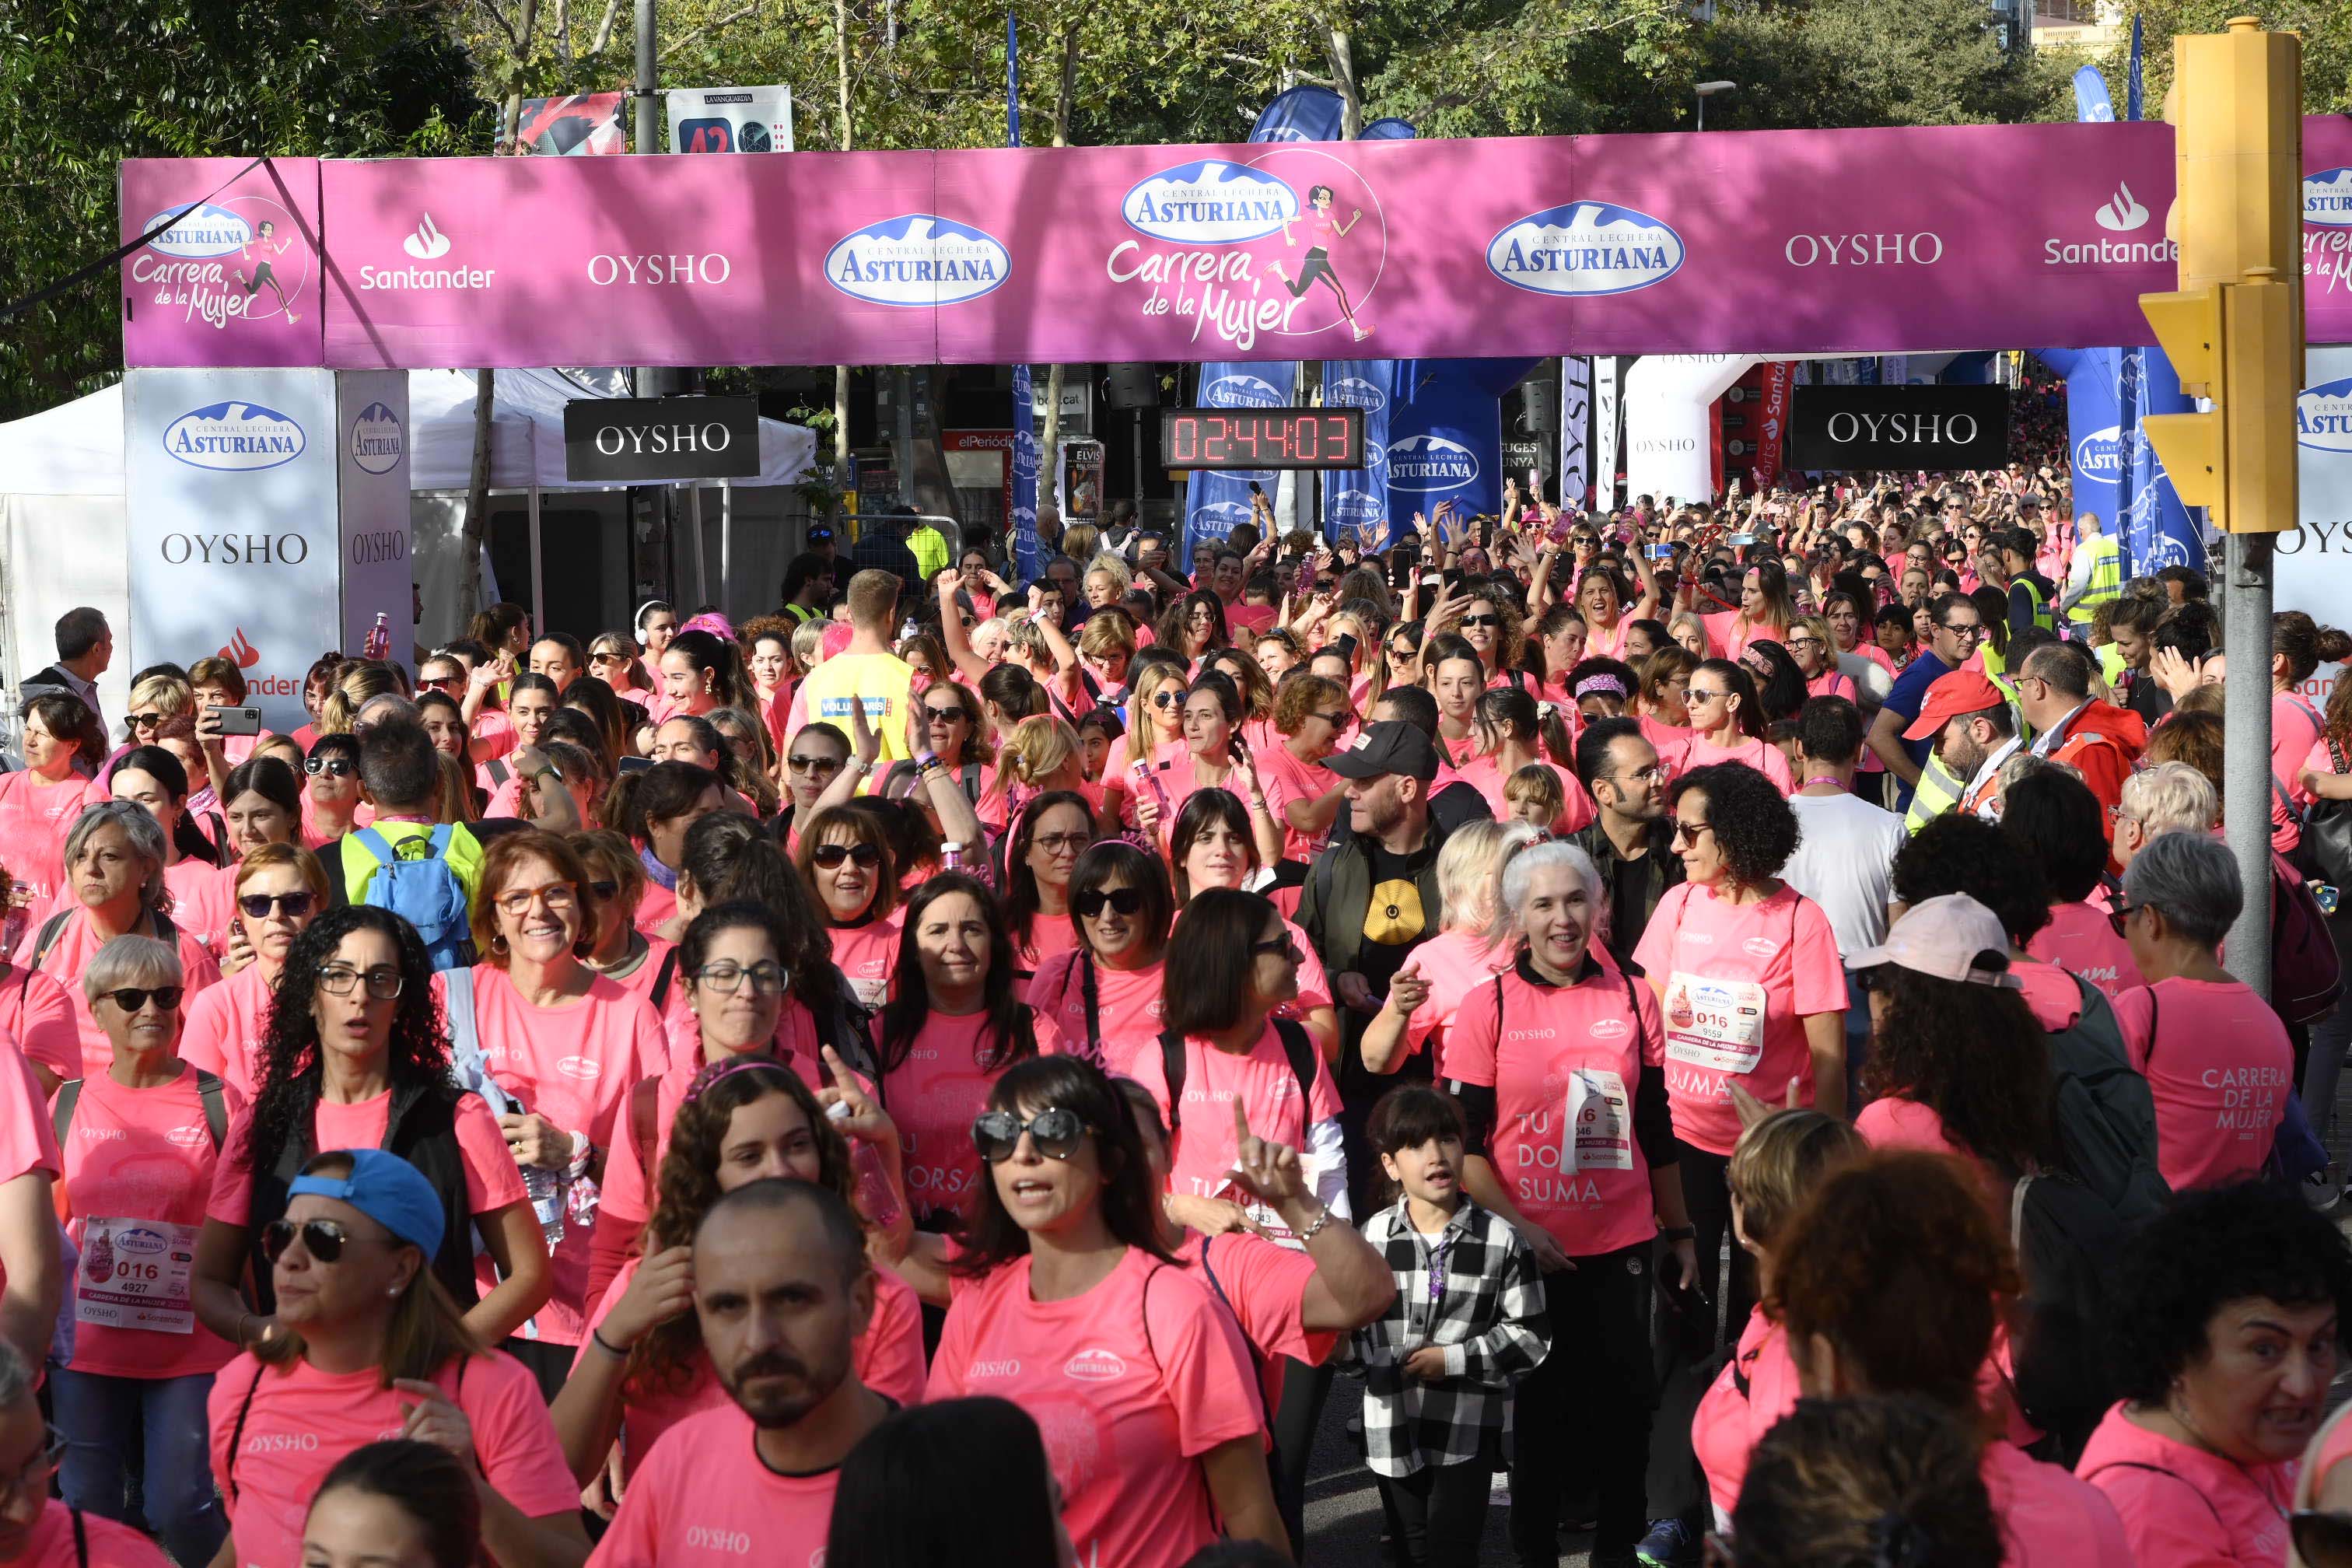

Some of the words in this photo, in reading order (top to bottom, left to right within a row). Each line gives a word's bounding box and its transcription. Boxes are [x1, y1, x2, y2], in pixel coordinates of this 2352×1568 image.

[1162, 189, 1217, 198] CENTRAL
[1223, 188, 1280, 197] LECHERA
[1136, 191, 1285, 223] ASTURIANA
[150, 223, 243, 244] ASTURIANA
[1532, 234, 1593, 244] CENTRAL
[1600, 233, 1663, 242] LECHERA
[867, 247, 926, 256] CENTRAL
[933, 246, 990, 255] LECHERA
[1502, 237, 1669, 272] ASTURIANA
[1785, 232, 1944, 266] OYSHO
[132, 254, 223, 285] Carrera
[587, 252, 731, 285] OYSHO
[839, 249, 997, 282] ASTURIANA
[1107, 240, 1253, 285] Carrera
[2317, 254, 2332, 275] la
[361, 264, 495, 290] Santander
[155, 285, 172, 305] de
[175, 284, 187, 305] la
[185, 281, 258, 329] Mujer
[1142, 286, 1170, 316] de
[1175, 285, 1195, 316] la
[1191, 278, 1307, 351] Mujer
[1211, 385, 1280, 408] ASTURIANA
[596, 422, 730, 455] OYSHO
[1175, 417, 1348, 461] 02:44:03
[1828, 412, 1977, 443] OYSHO
[174, 427, 296, 453] ASTURIANA
[355, 429, 401, 457] ASTURIANA
[1636, 438, 1695, 454] OYSHO
[1076, 450, 1101, 460] ELVIS
[161, 533, 308, 565] OYSHO
[352, 530, 404, 565] OYSHO
[1697, 1013, 1728, 1028] 016
[1508, 1027, 1556, 1041] OYSHO
[1703, 1027, 1722, 1038] 9559
[1674, 1045, 1700, 1059] OYSHO
[1670, 1066, 1732, 1097] SUMA
[2202, 1068, 2287, 1089] CARRERA
[2224, 1089, 2251, 1108] DE
[2256, 1088, 2273, 1108] LA
[1516, 1111, 1549, 1134] TU
[2216, 1109, 2273, 1129] MUJER
[79, 1127, 126, 1140] OYSHO
[1519, 1177, 1601, 1202] SUMA
[117, 1262, 159, 1279] 016
[121, 1283, 149, 1293] 4927
[84, 1306, 117, 1319] OYSHO
[970, 1359, 1020, 1377] OYSHO
[248, 1433, 319, 1454] OYSHO
[686, 1525, 751, 1555] OYSHO
